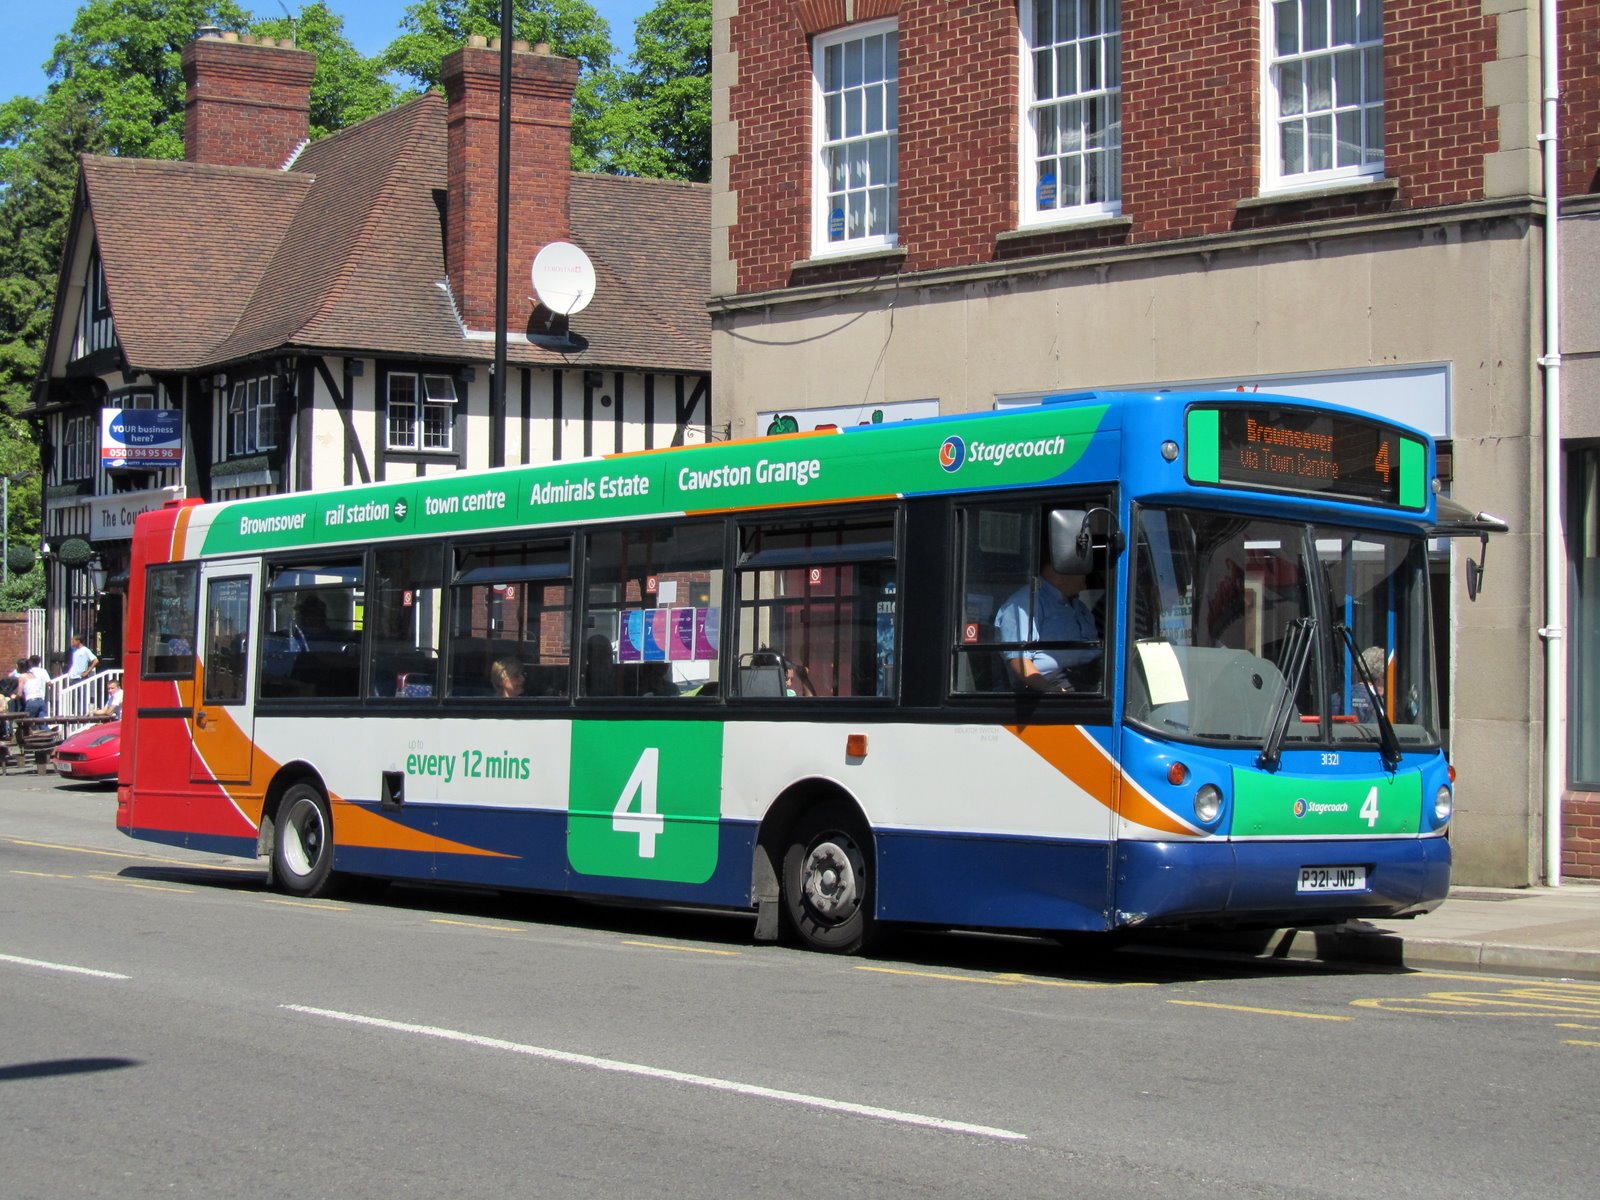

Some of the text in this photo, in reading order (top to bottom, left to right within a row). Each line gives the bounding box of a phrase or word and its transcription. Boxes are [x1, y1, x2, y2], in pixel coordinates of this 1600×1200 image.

[112, 425, 136, 433] YOUR
[131, 434, 154, 442] here?
[1247, 419, 1334, 451] Brownsover
[109, 449, 174, 457] 0500 94 95 96
[968, 435, 1065, 466] Stagecoach
[1240, 446, 1339, 479] via Town Centre
[1375, 441, 1390, 483] 4
[678, 459, 820, 491] Cawston Grange
[530, 474, 650, 505] Admirals Estate
[325, 500, 390, 526] rail station
[425, 491, 506, 515] town centre
[102, 509, 117, 528] The
[240, 513, 306, 535] Brownsover
[406, 750, 530, 783] every 12 mins
[1321, 753, 1339, 765] 31321
[612, 747, 665, 858] 4
[1308, 801, 1348, 814] Stagecoach
[1359, 786, 1379, 827] 4
[1302, 869, 1356, 888] P321 JND
